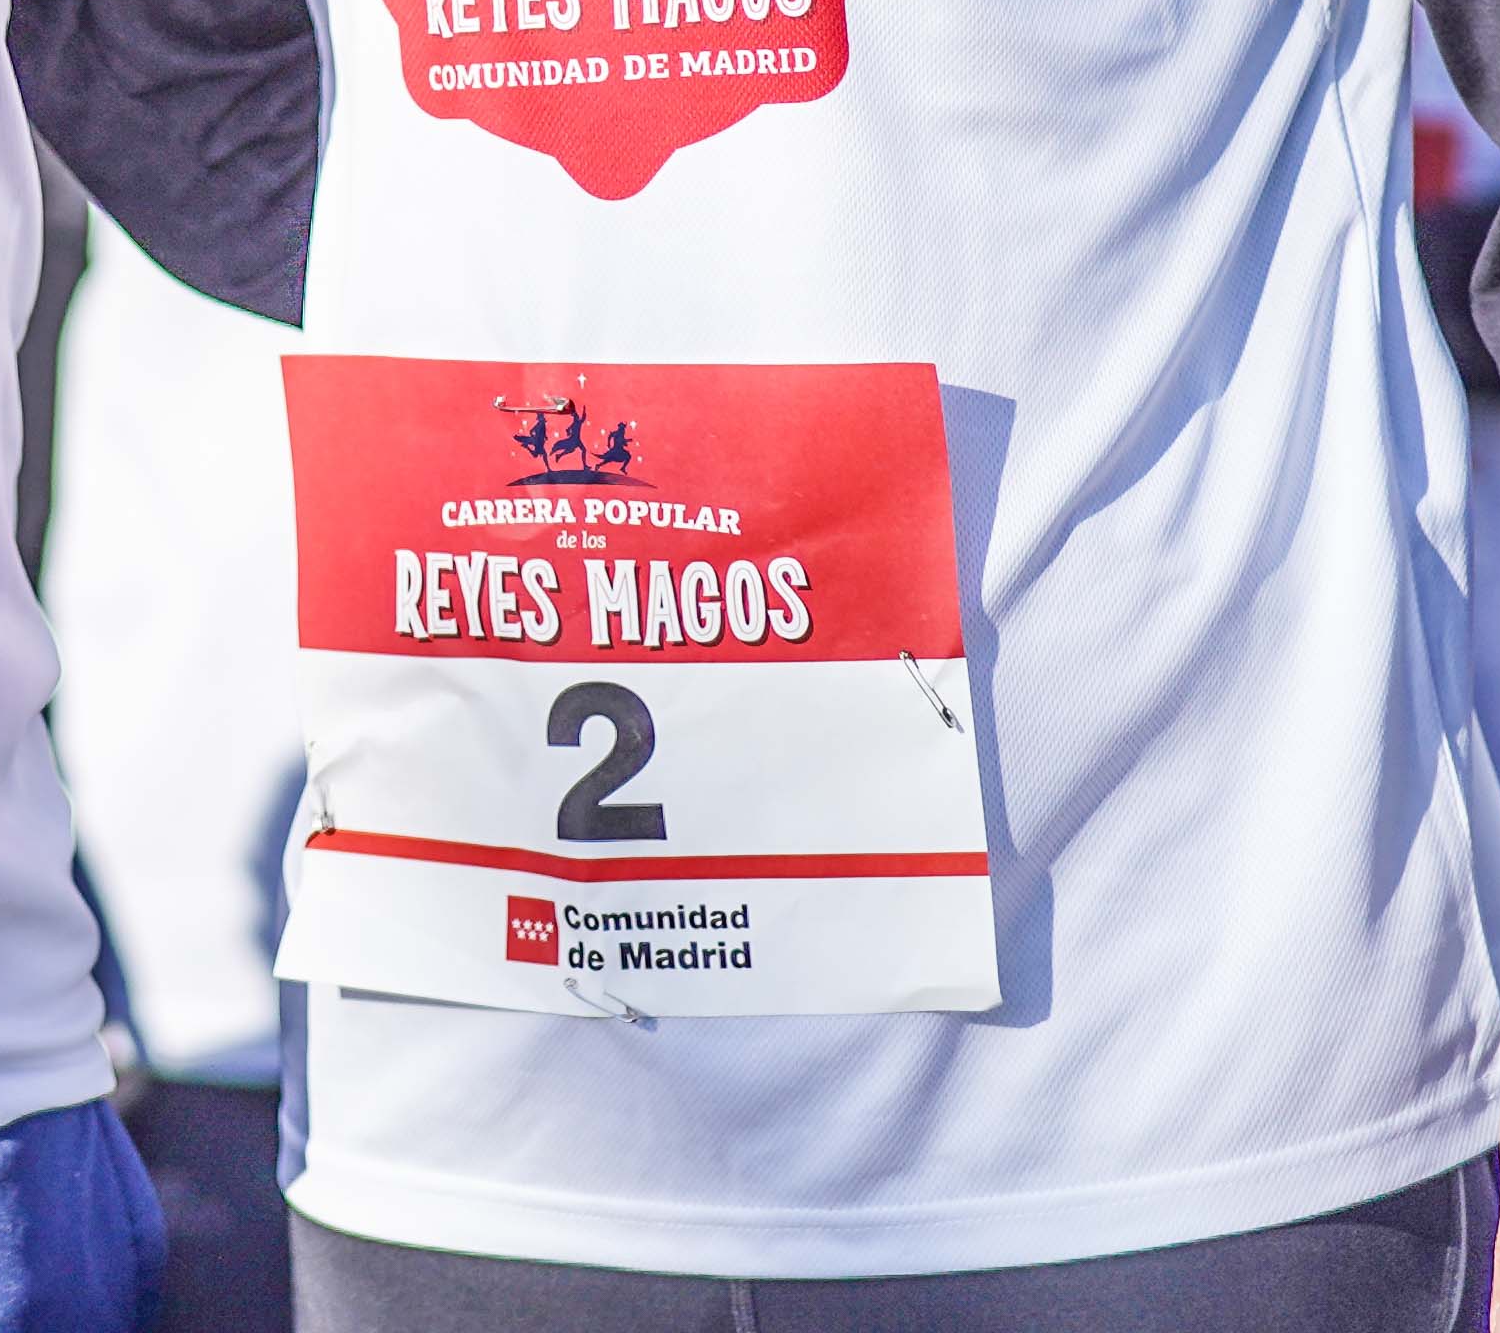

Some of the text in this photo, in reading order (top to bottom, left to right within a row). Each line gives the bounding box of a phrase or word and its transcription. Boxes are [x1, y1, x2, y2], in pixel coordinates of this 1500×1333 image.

[429, 47, 816, 91] COMUNIDAD DE MADRID
[441, 499, 741, 535] CARRERA POPULAR
[557, 531, 606, 549] de los
[394, 549, 810, 648] REYES MAGOS
[547, 681, 667, 841] 2
[564, 904, 749, 932] Comunidad
[569, 943, 752, 971] de Madrid
